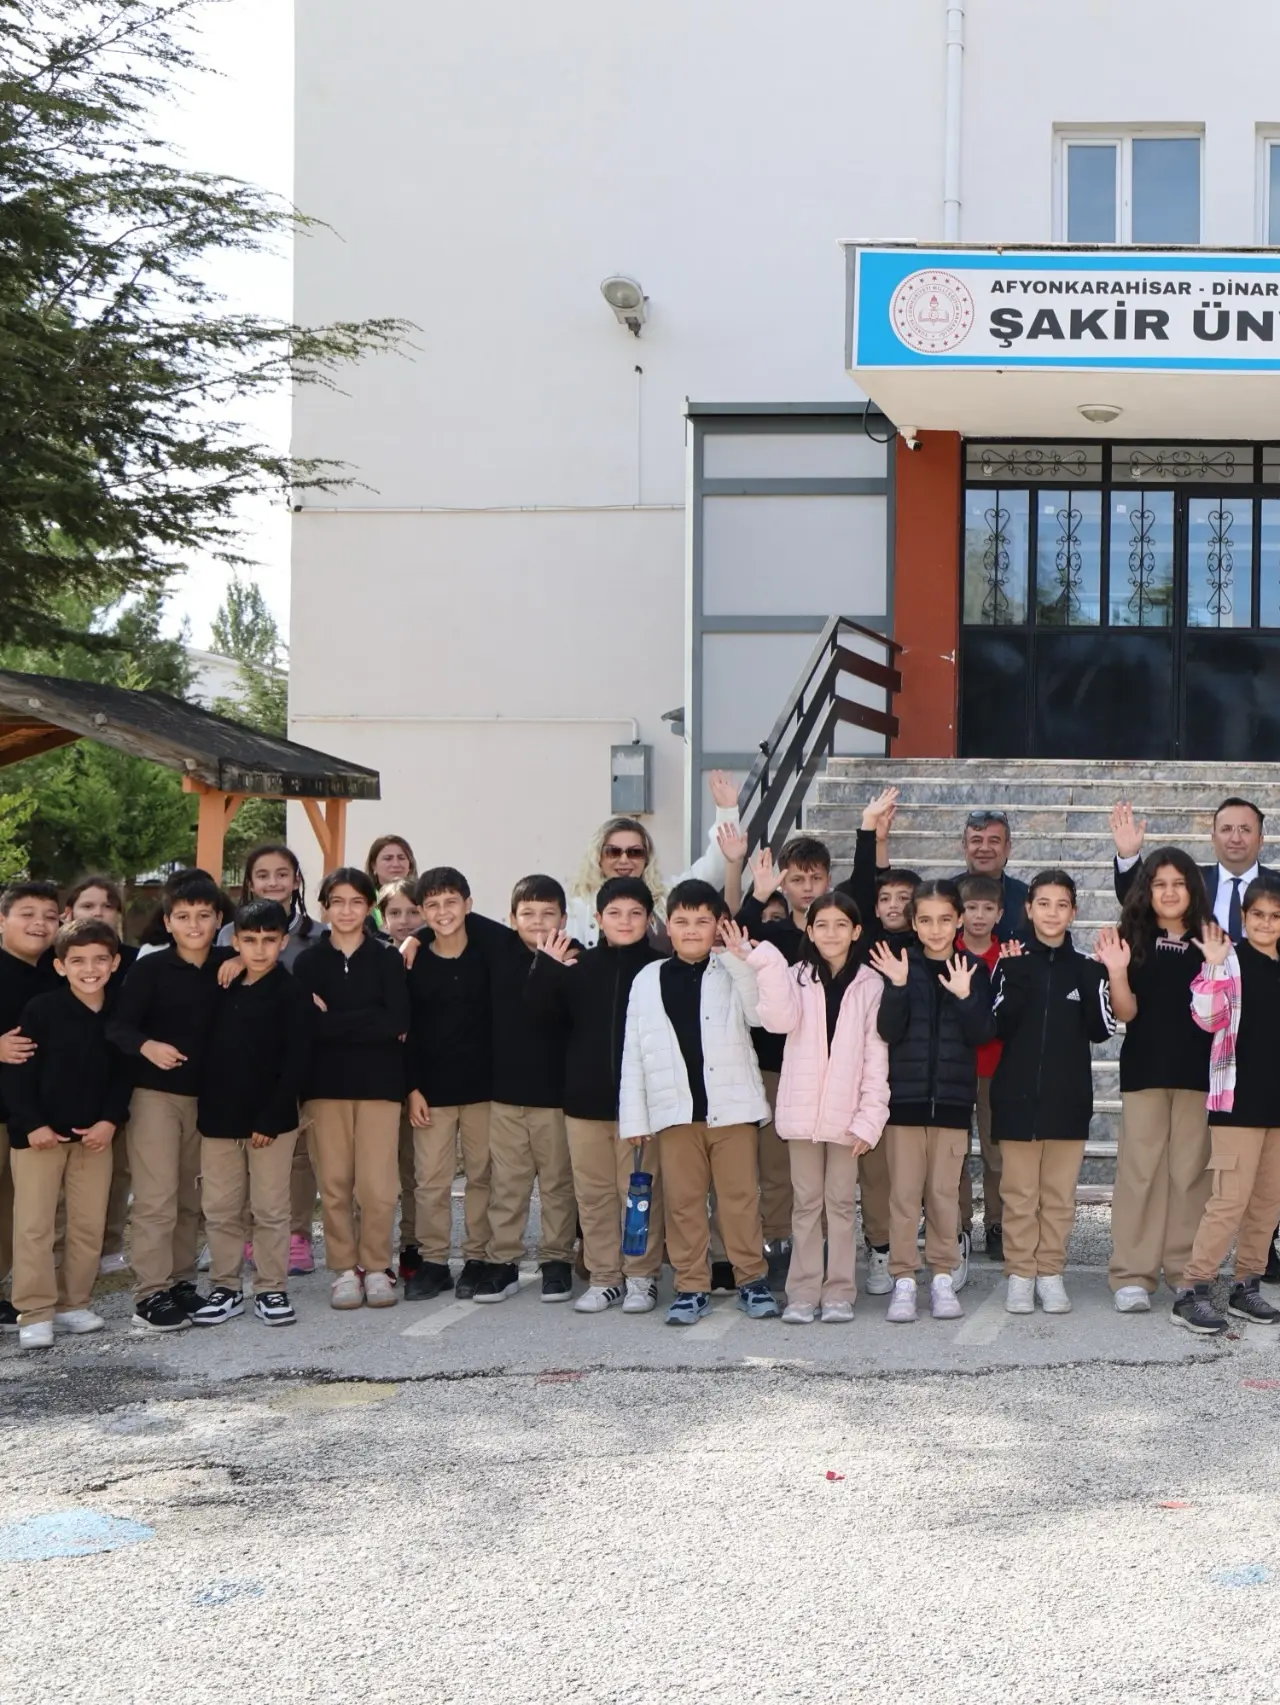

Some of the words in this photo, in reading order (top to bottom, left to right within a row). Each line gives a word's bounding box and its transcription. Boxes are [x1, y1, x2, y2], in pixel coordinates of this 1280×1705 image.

[990, 277, 1192, 296] AFYONKARAHİSAR
[1212, 279, 1279, 297] DİNAR
[989, 300, 1170, 348] ŞAKİR
